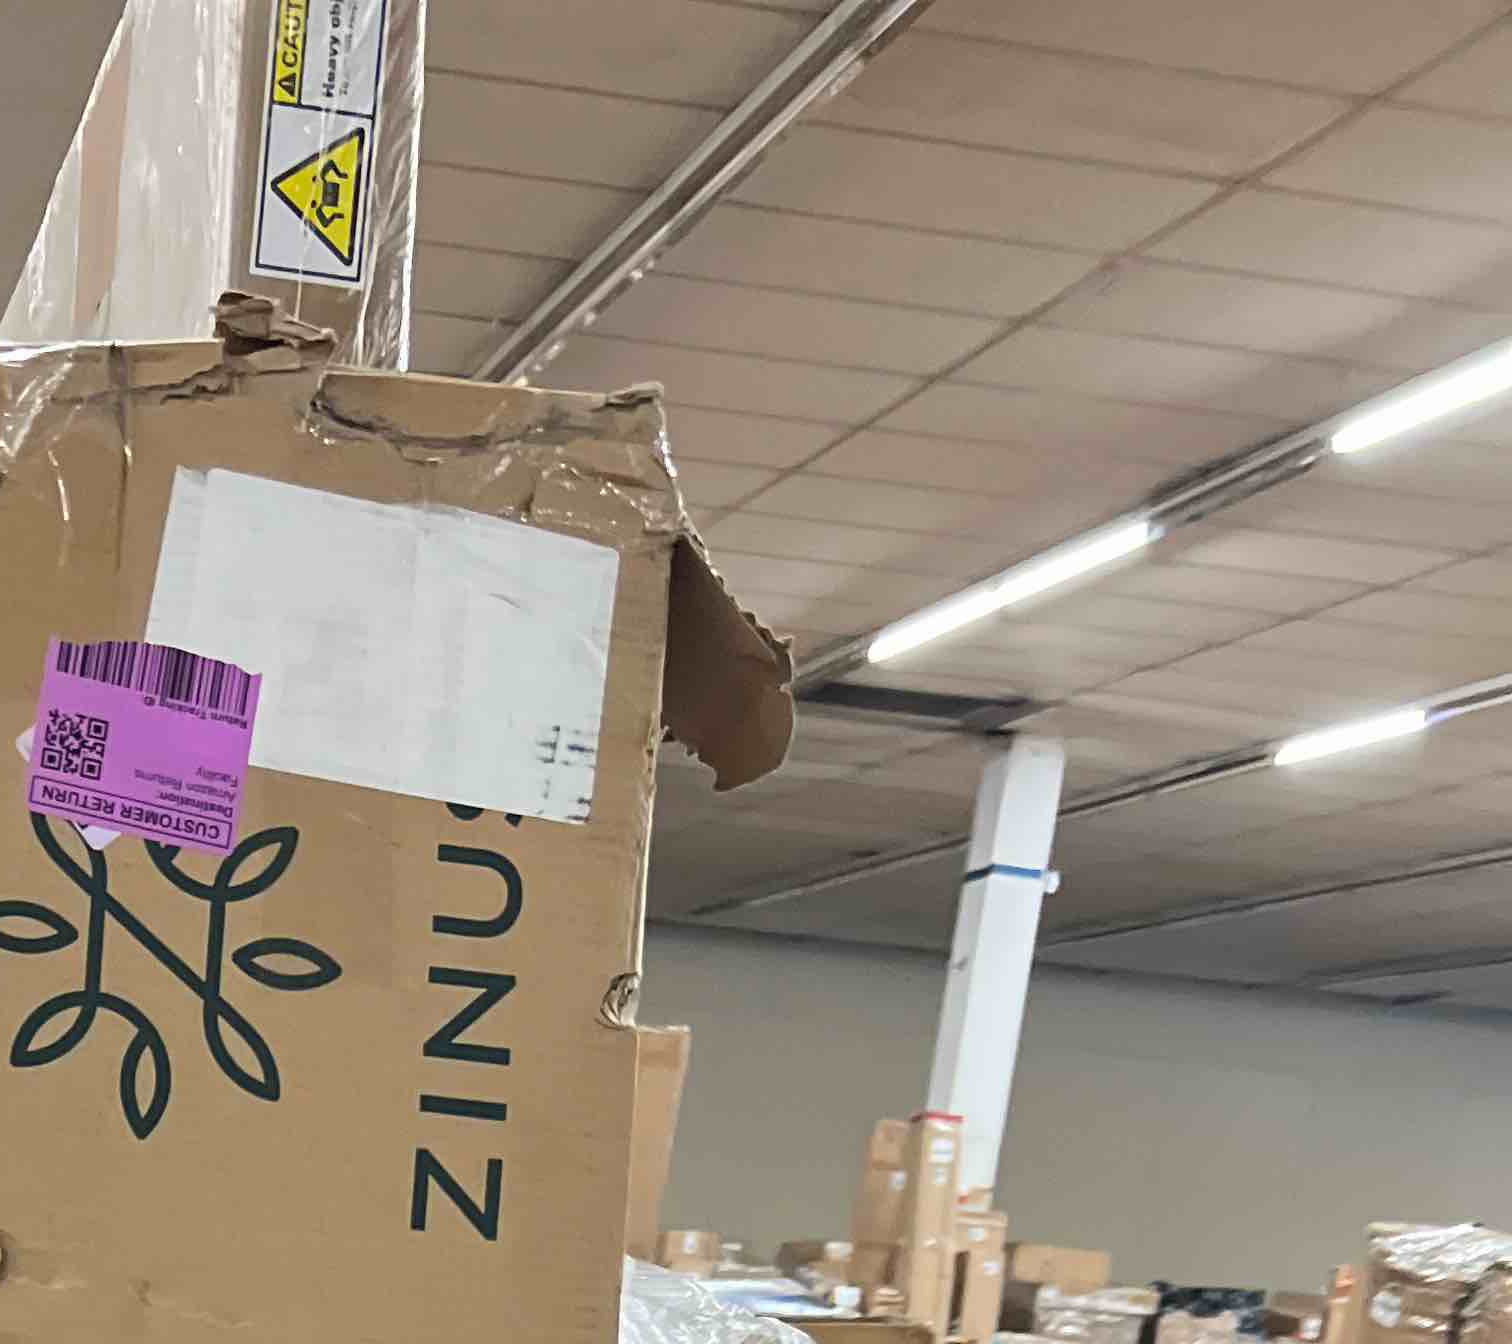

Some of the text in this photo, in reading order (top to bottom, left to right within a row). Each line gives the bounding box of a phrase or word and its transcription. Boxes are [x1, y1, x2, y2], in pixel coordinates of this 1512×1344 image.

[322, 33, 340, 98] Heavy
[42, 784, 220, 840] CUSTOMER RETURN
[159, 790, 233, 818] Destination:
